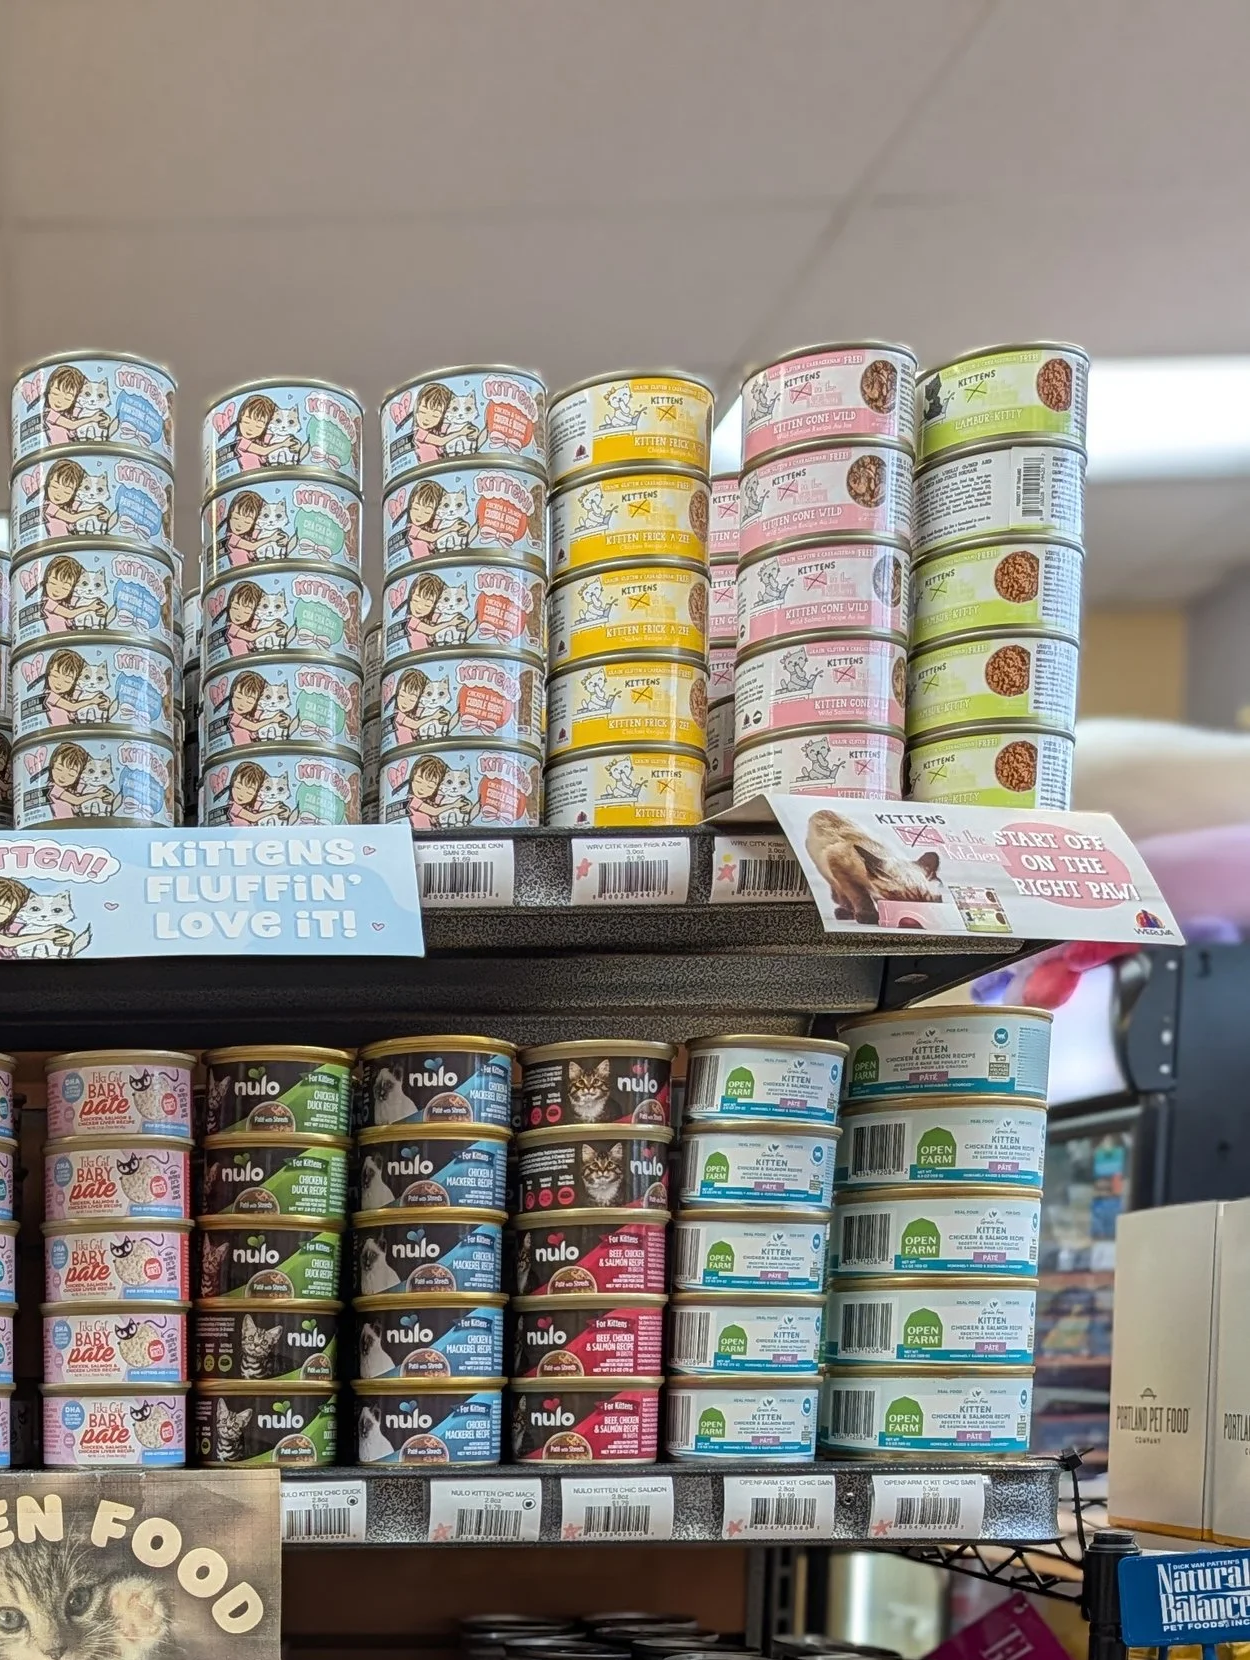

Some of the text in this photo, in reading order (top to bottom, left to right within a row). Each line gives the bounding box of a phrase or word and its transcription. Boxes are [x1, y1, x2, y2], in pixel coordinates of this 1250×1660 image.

[958, 369, 996, 388] KITTENS
[773, 411, 857, 435] KITTEN GONE WILD
[876, 814, 946, 825] KITTENS
[964, 830, 986, 845] the
[994, 831, 1105, 851] START OFF
[1021, 854, 1107, 874] ON THE
[1014, 879, 1141, 901] RIGHT PAW!
[1134, 928, 1175, 936] WERUVA
[234, 1075, 280, 1096] nulo
[307, 1101, 338, 1112] DUCK RECIPE
[991, 1136, 1020, 1145] KITTEN
[920, 1145, 953, 1156] OPEN
[920, 1155, 953, 1165] FARM
[997, 1162, 1013, 1171] PÂTÉ
[1116, 1406, 1189, 1433] PORTLAND PET FOOD
[91, 1499, 264, 1634] FOOD
[1157, 1558, 1250, 1594] Natural
